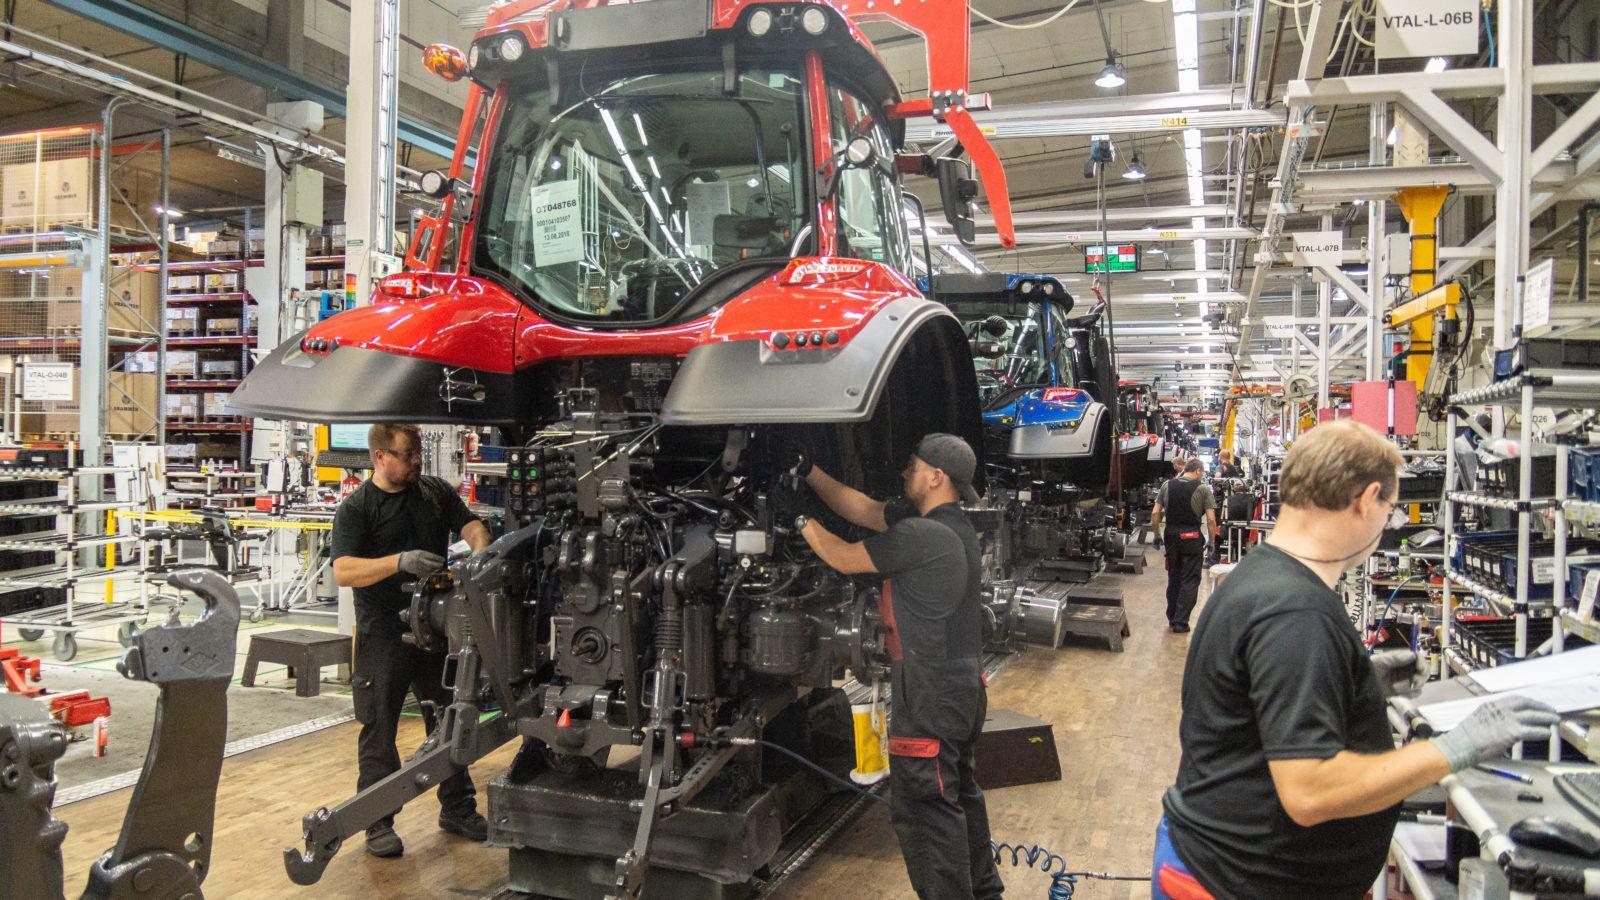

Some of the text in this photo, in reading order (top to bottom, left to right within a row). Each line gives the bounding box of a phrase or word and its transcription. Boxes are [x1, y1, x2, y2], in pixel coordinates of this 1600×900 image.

[1383, 11, 1473, 28] VTAL-L-06B
[1161, 117, 1188, 126] N414
[1295, 244, 1340, 253] VTAL-L-07B
